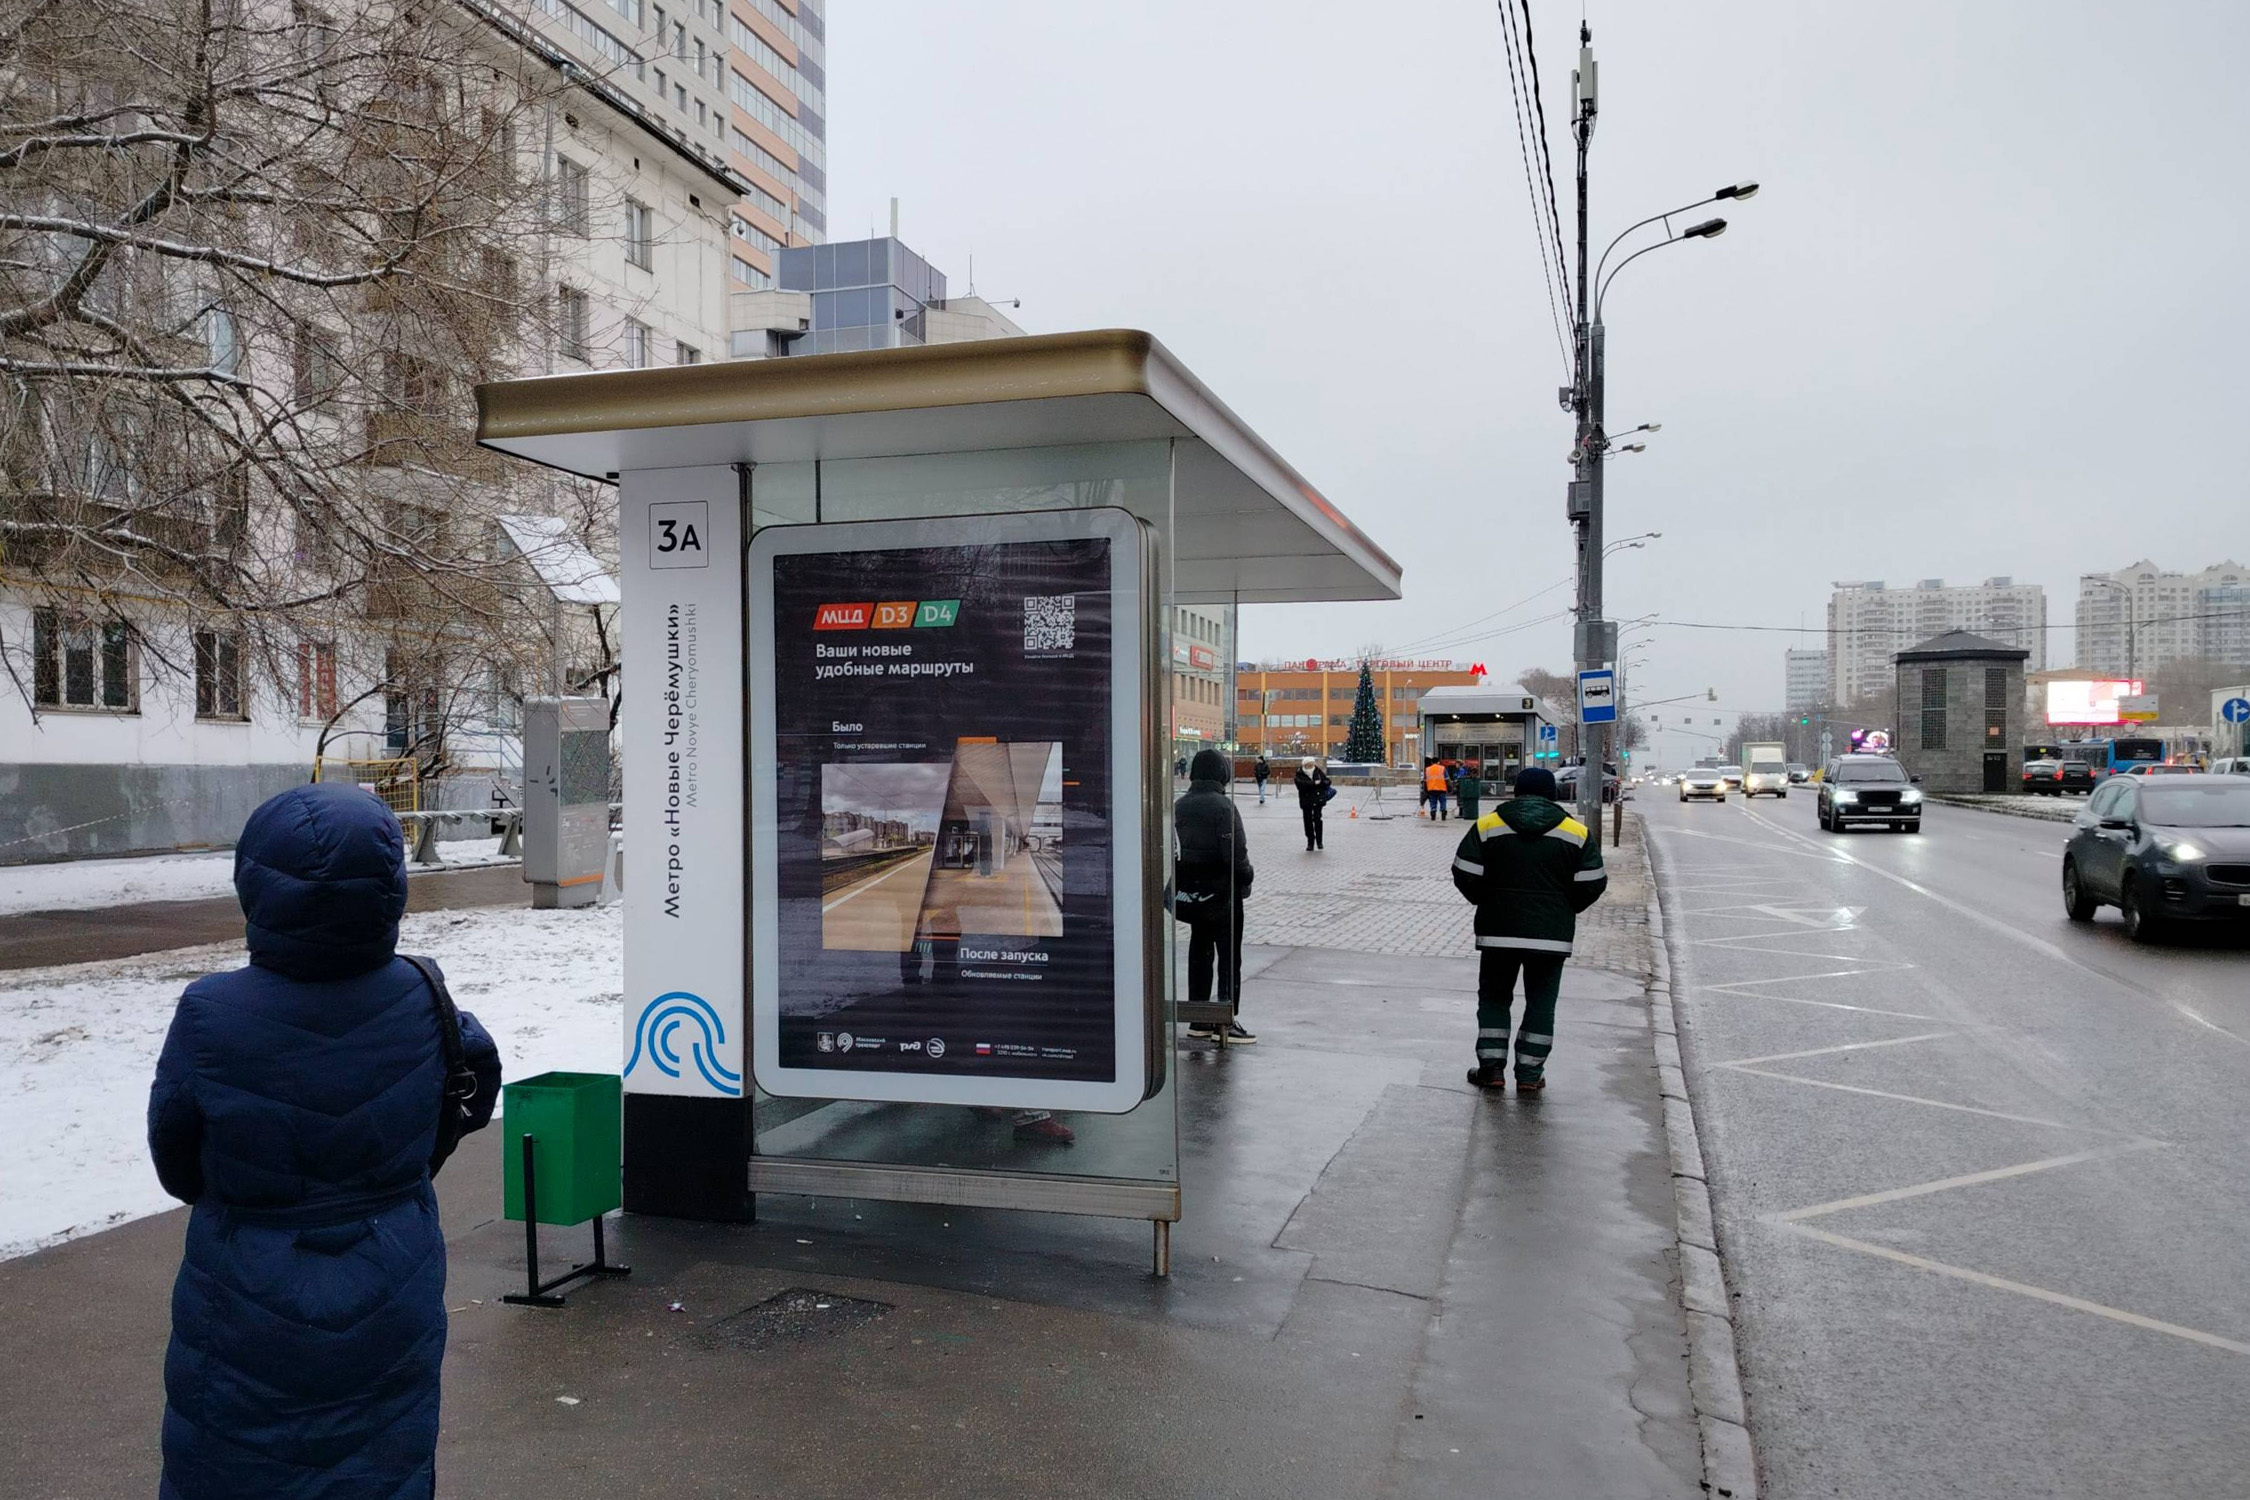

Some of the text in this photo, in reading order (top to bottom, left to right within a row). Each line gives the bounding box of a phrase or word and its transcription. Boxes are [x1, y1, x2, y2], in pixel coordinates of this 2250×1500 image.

[657, 519, 702, 552] 3А
[821, 604, 952, 625] МЦД D3 D4
[816, 643, 913, 658] Ваши новые
[815, 661, 975, 680] удобные маршруты
[1418, 660, 1453, 669] ЦЕНТР
[685, 603, 700, 809] Metro Novye Cheryomushki
[832, 721, 863, 732] Было
[833, 742, 856, 750] Только
[664, 603, 684, 919] Метро «Новые Черёмушки»
[960, 948, 1049, 963] После запуска
